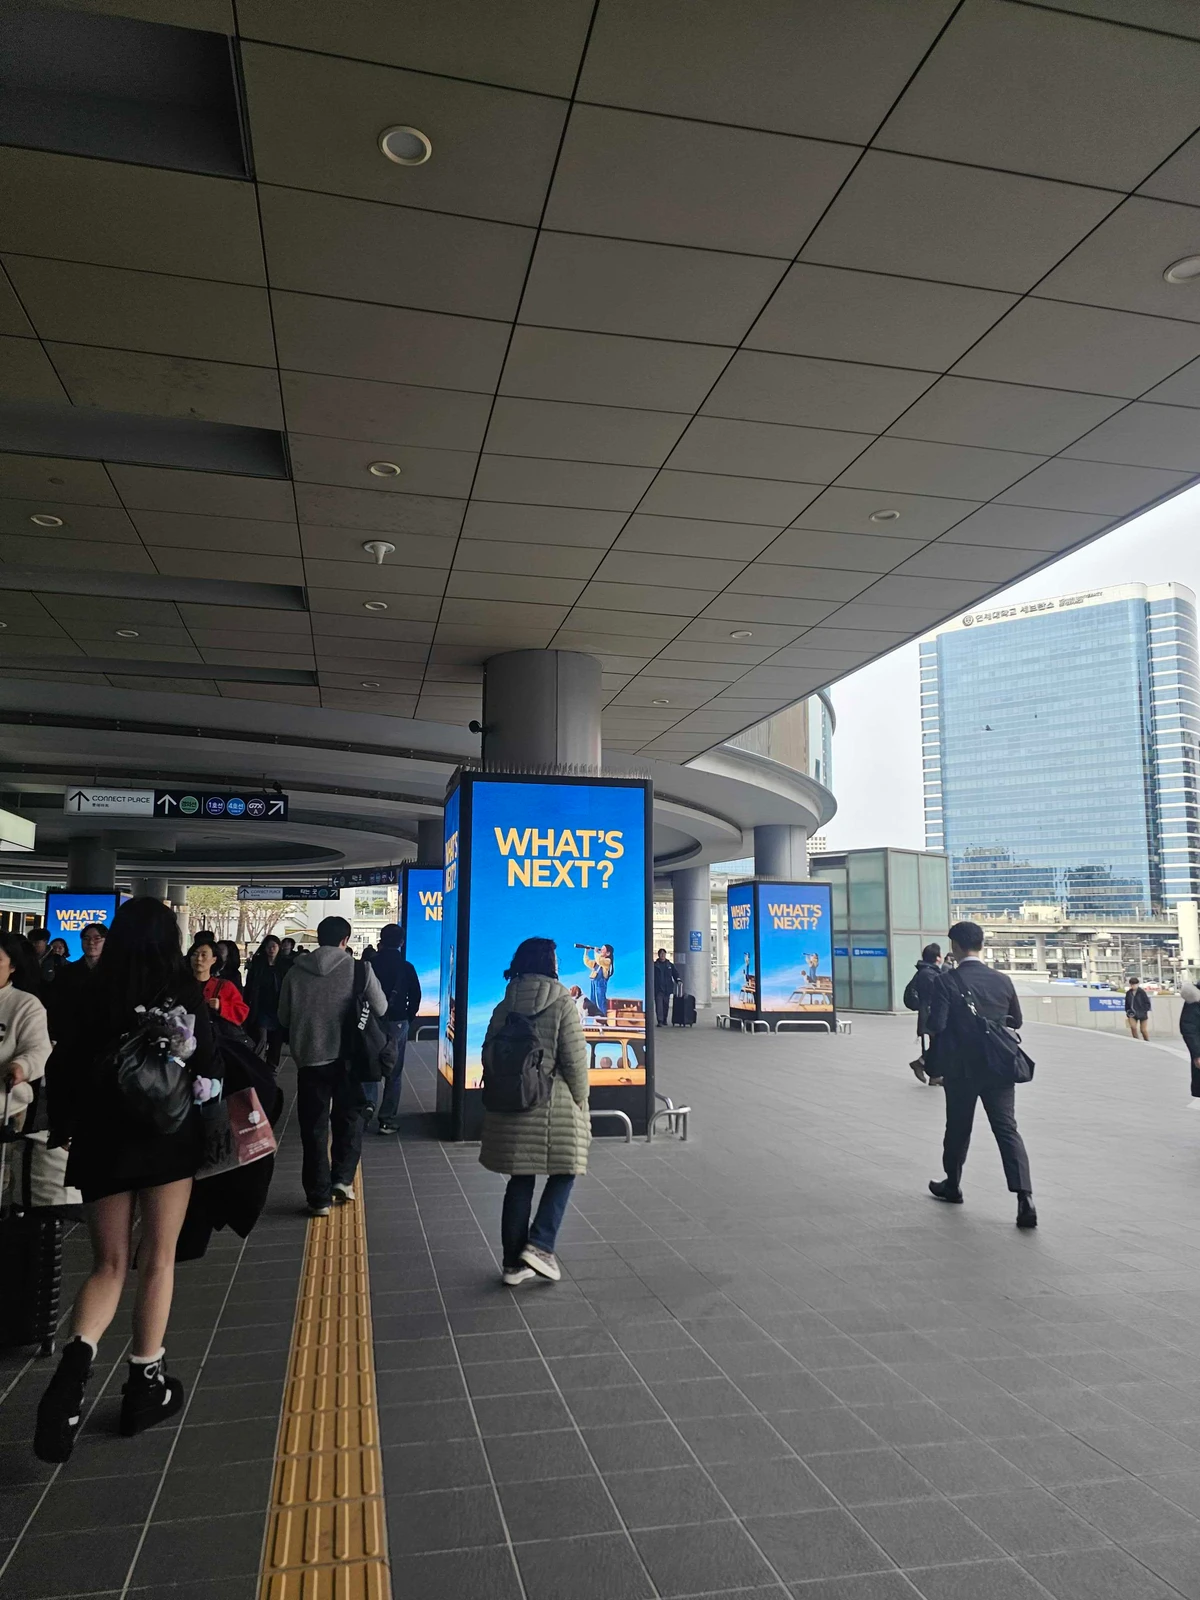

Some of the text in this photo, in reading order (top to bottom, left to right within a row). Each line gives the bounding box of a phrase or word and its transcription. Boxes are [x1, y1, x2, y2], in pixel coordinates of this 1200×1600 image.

[92, 795, 150, 804] CONNECT PLACE
[494, 827, 625, 859] WHAT'S
[507, 858, 614, 888] NEXT?
[56, 909, 107, 921] WHAT'S
[731, 904, 751, 917] WHAT'S
[768, 903, 822, 917] WHAT'S
[732, 917, 750, 930] NEXT?
[773, 917, 818, 930] NEXT?
